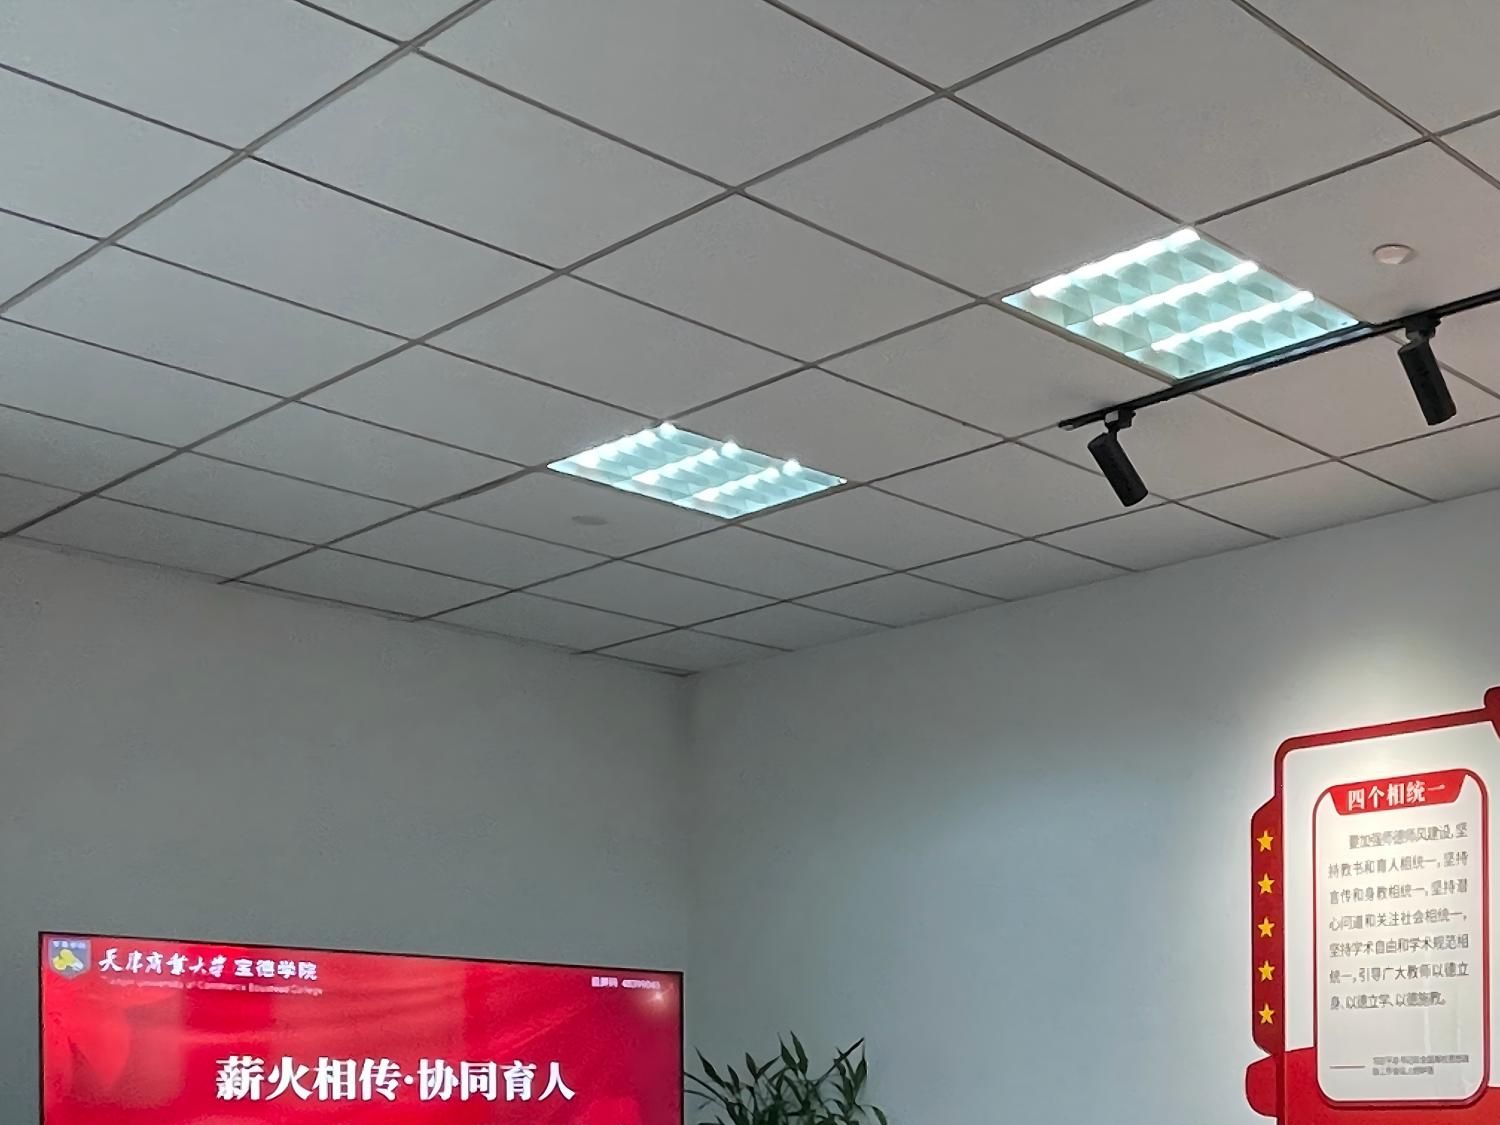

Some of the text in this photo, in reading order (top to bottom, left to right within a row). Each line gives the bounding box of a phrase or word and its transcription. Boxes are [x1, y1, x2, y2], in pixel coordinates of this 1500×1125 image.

[1348, 780, 1446, 811] 四个相统一
[234, 957, 318, 981] 宝德学院
[216, 1055, 576, 1101] 薪火相传·协同育人
